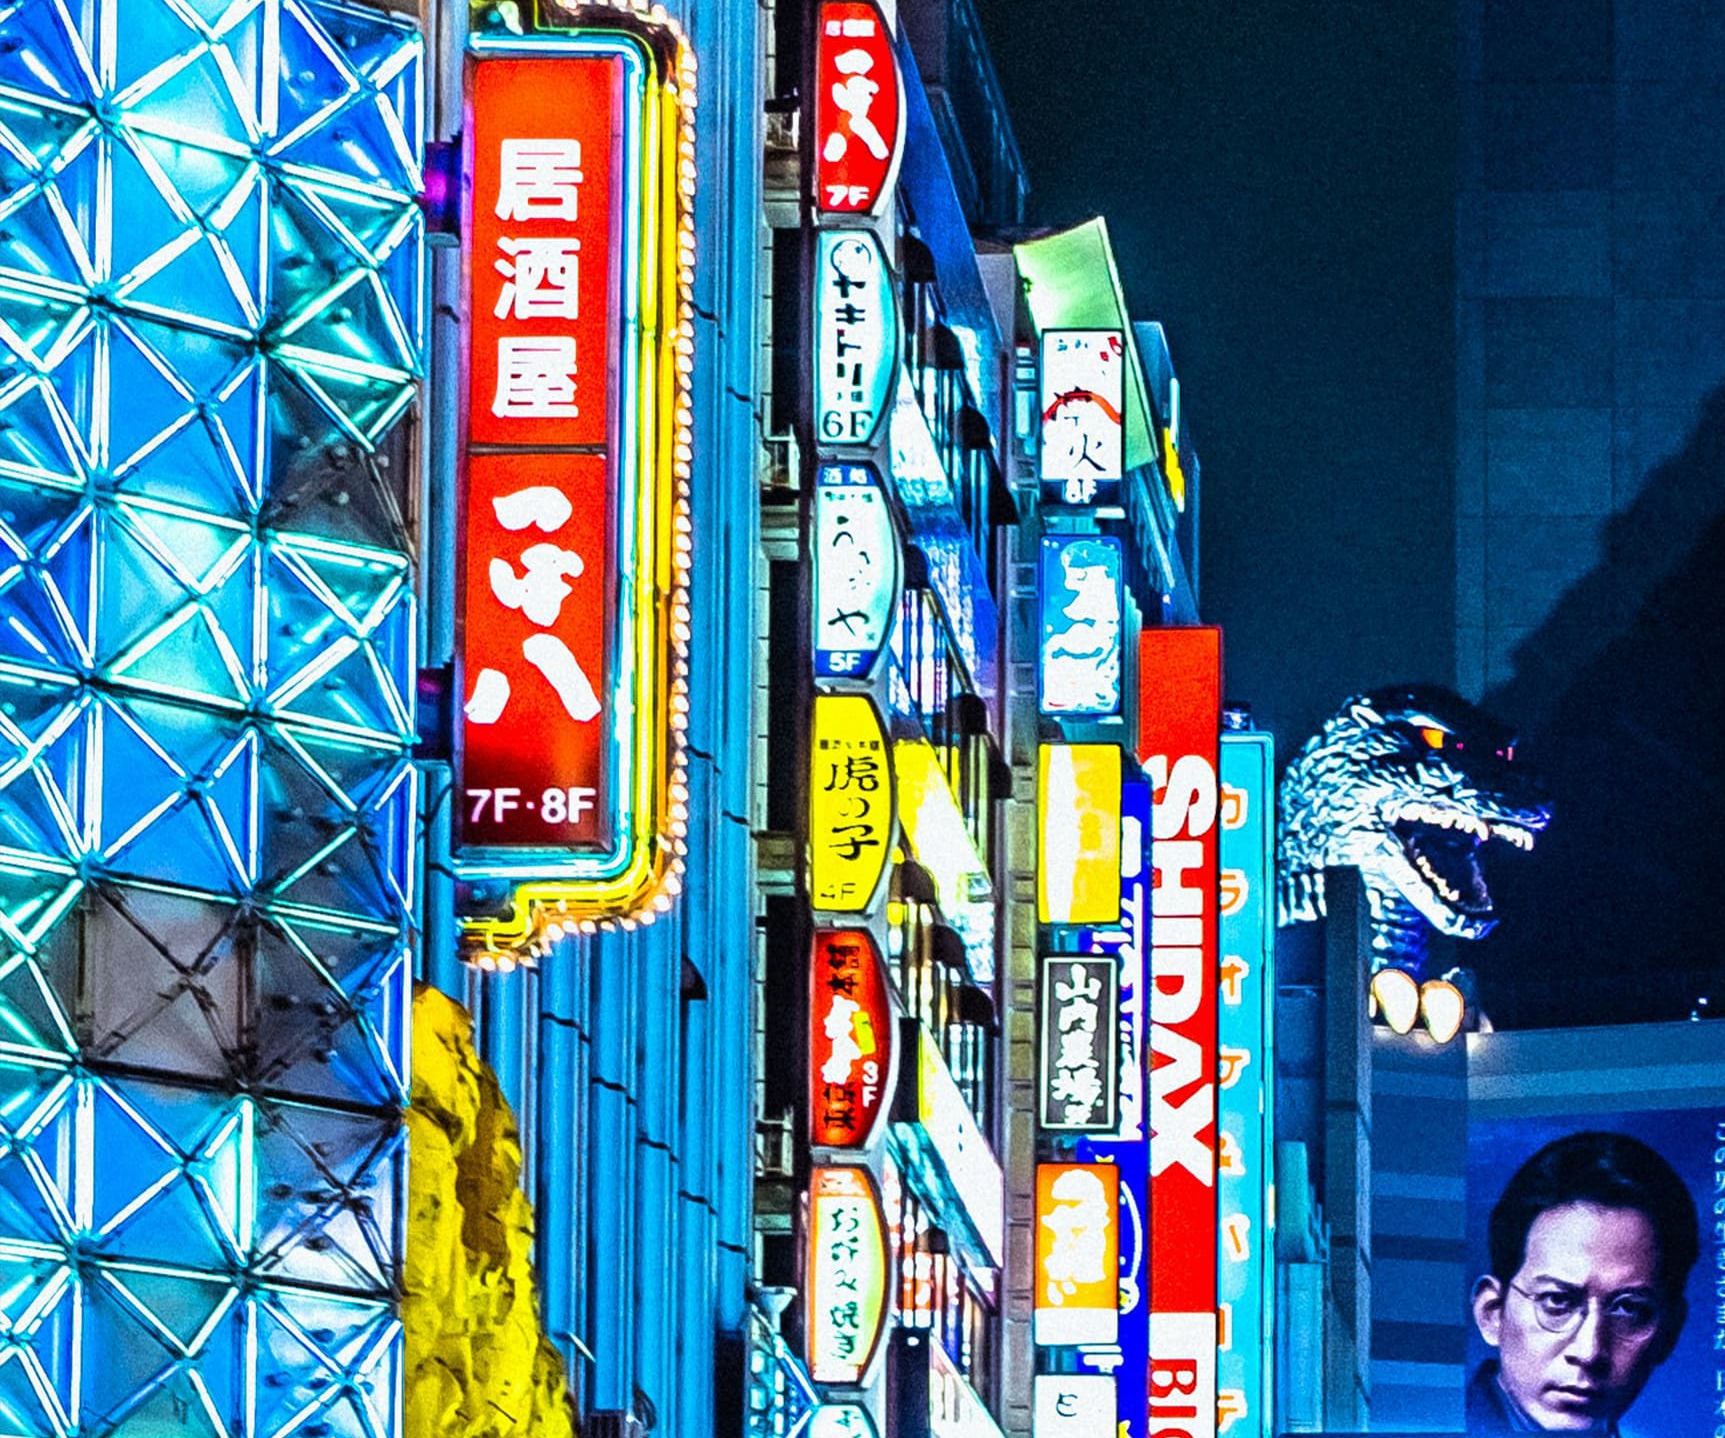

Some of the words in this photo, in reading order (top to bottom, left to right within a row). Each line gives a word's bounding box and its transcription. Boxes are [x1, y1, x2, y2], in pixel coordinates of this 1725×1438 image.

[826, 186, 870, 207] 7F
[489, 138, 584, 421] 居酒屋
[822, 410, 873, 439] 6F
[823, 756, 880, 860] 虎の子
[1147, 755, 1219, 1187] SHIDAX
